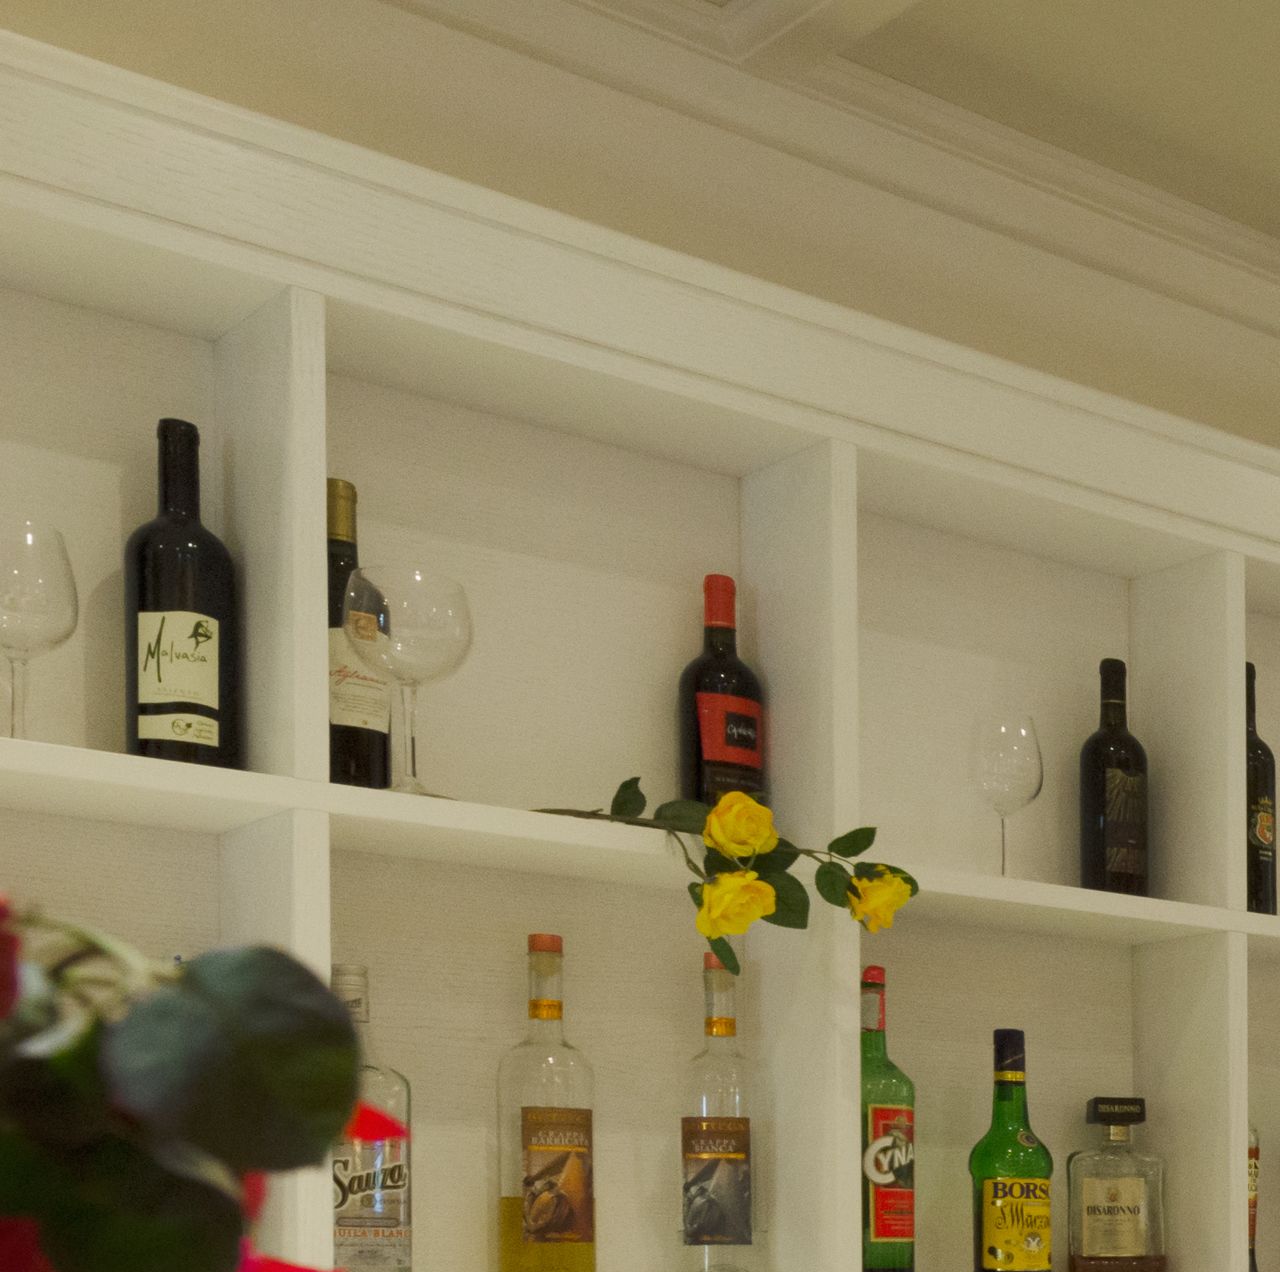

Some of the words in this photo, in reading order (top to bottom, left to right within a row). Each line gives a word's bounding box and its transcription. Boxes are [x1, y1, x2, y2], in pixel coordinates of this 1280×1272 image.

[143, 615, 208, 683] Malvasia
[333, 1160, 408, 1210] Sauza
[1086, 1206, 1141, 1216] DISARONNO
